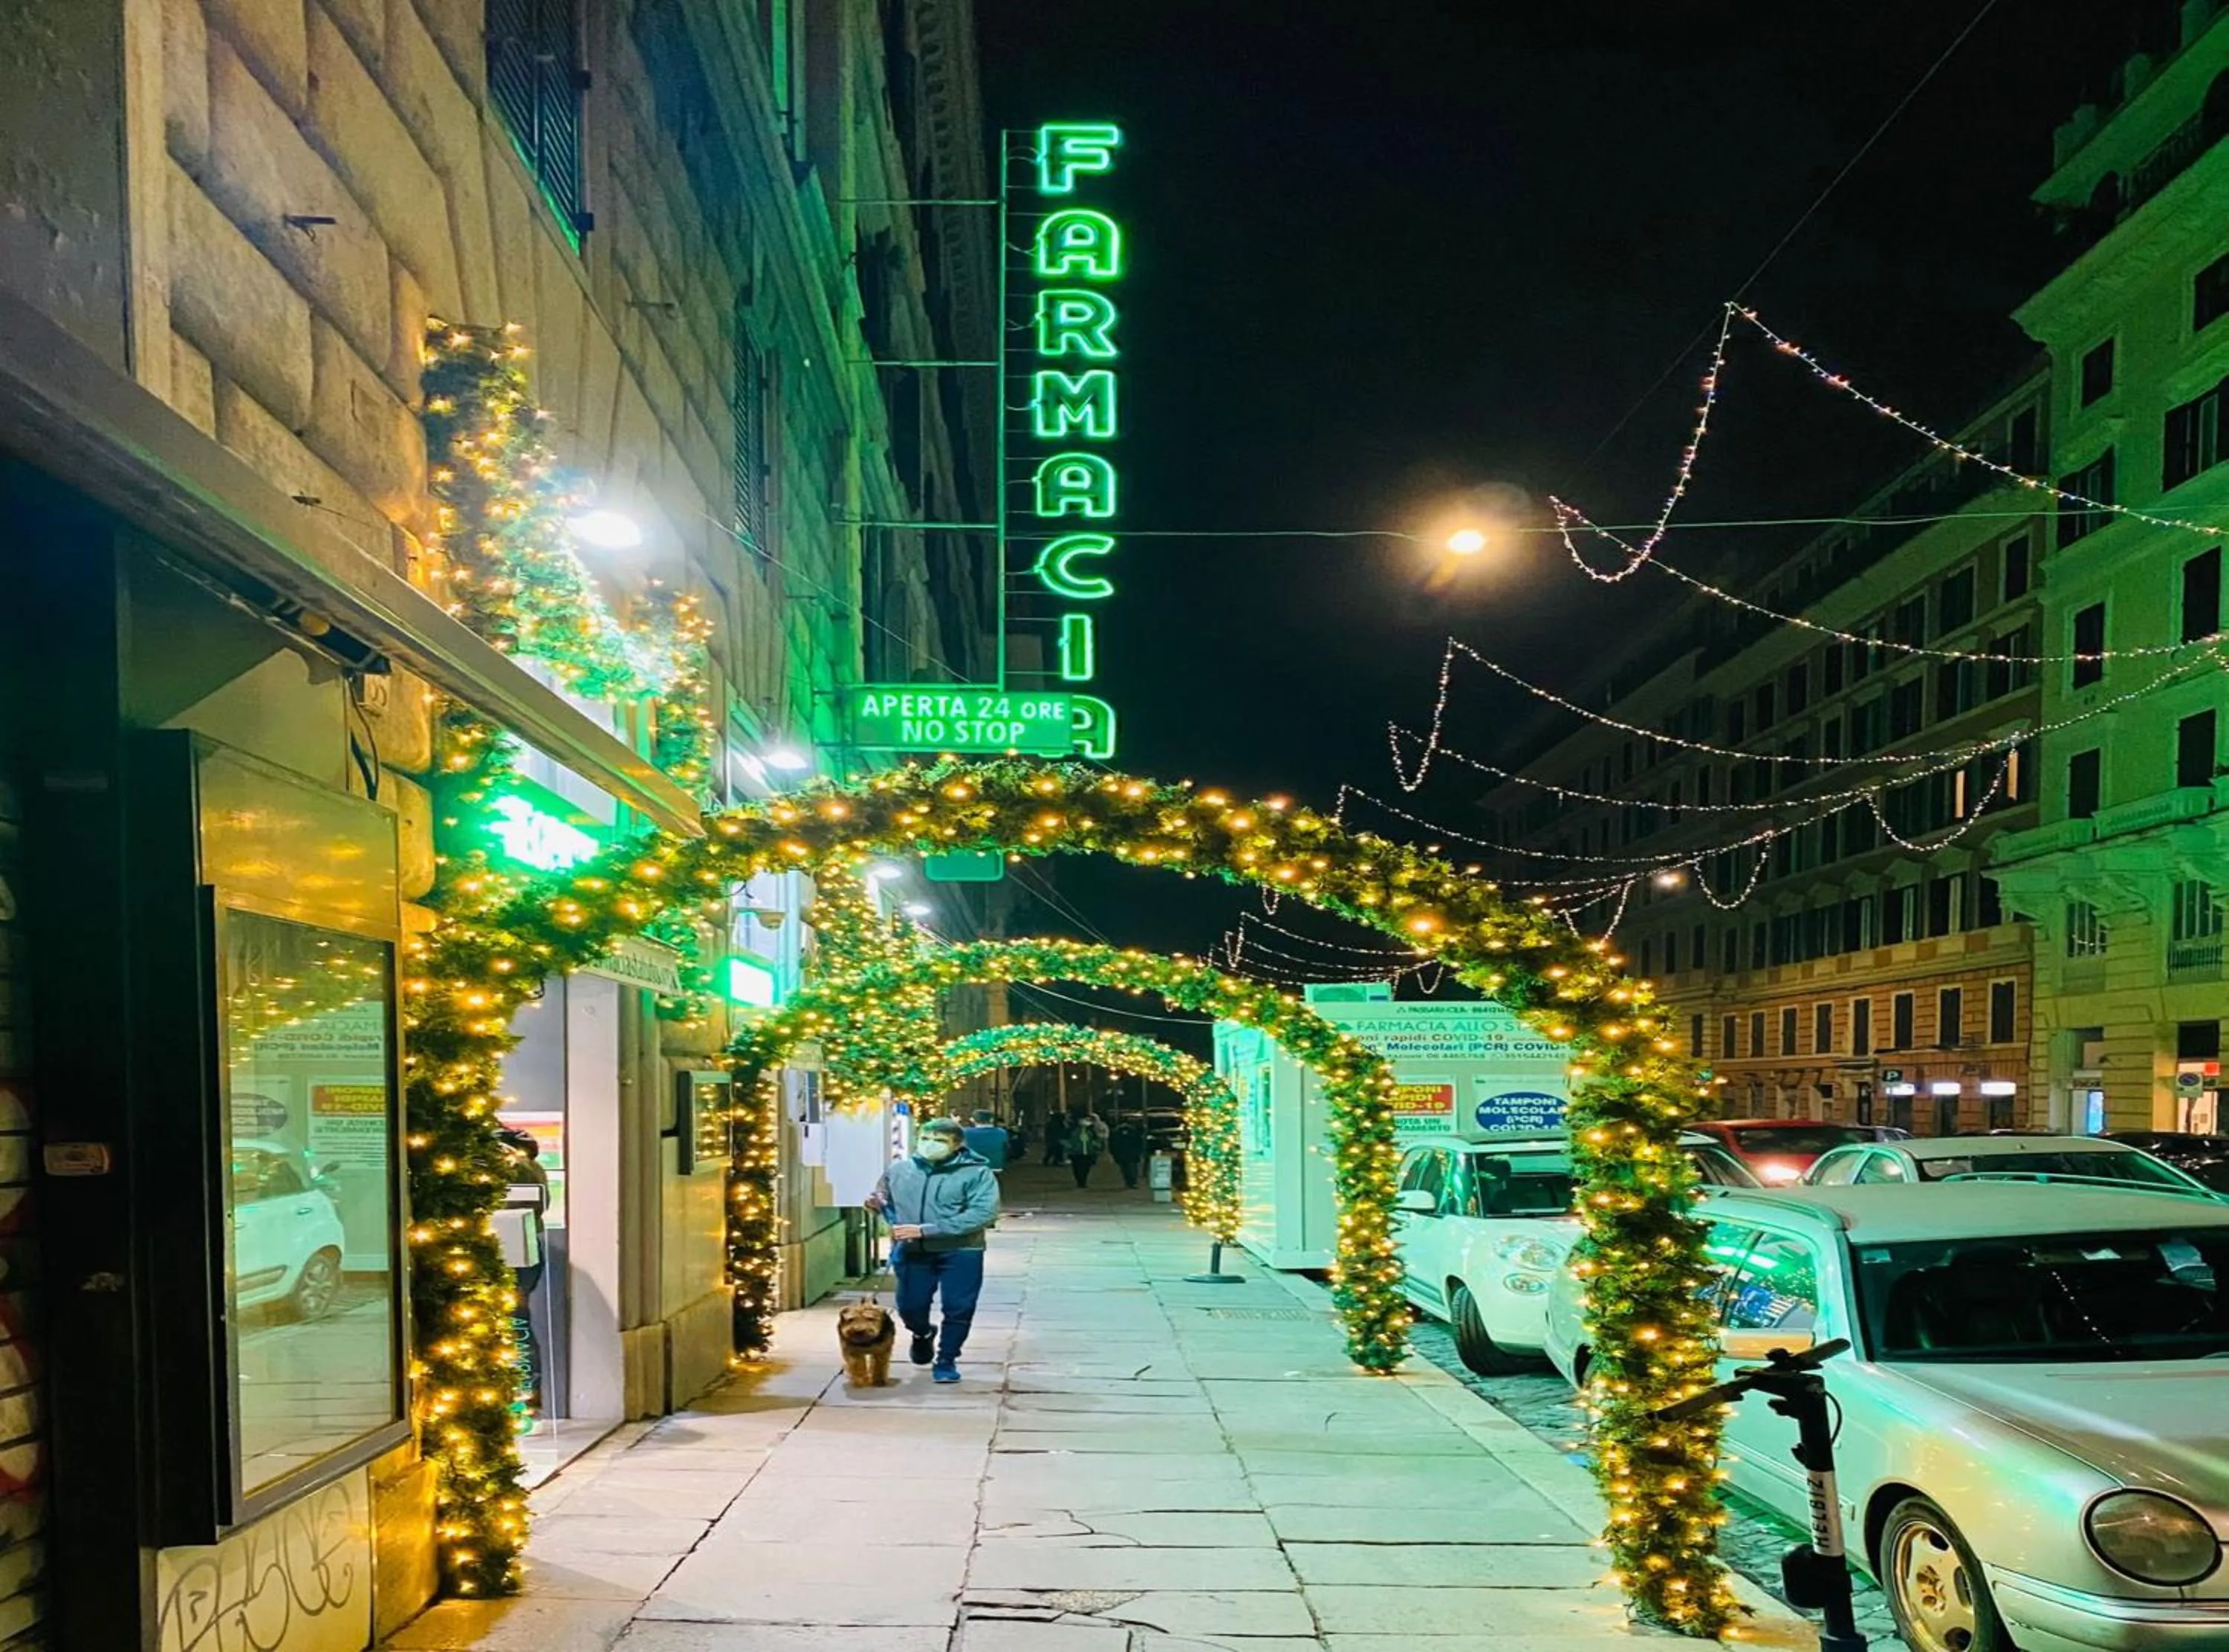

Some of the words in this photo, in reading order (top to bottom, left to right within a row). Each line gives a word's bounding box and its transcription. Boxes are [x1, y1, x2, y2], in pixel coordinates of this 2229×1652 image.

[1035, 123, 1121, 759] FARMACIA
[862, 695, 967, 718] APERTA
[977, 695, 1011, 720] 24
[1020, 701, 1065, 720] ORE
[901, 719, 945, 742] NO
[954, 721, 1026, 744] STOP
[1356, 1020, 1447, 1032] FARMACIA
[1387, 1042, 1464, 1051] Molecolari
[1513, 1043, 1566, 1051] COVID-
[1886, 1070, 1900, 1081] P
[1493, 1097, 1557, 1105] TAMPONI
[1479, 1106, 1566, 1115] MOLECOLA
[1806, 1477, 1829, 1548] HELBIZ
